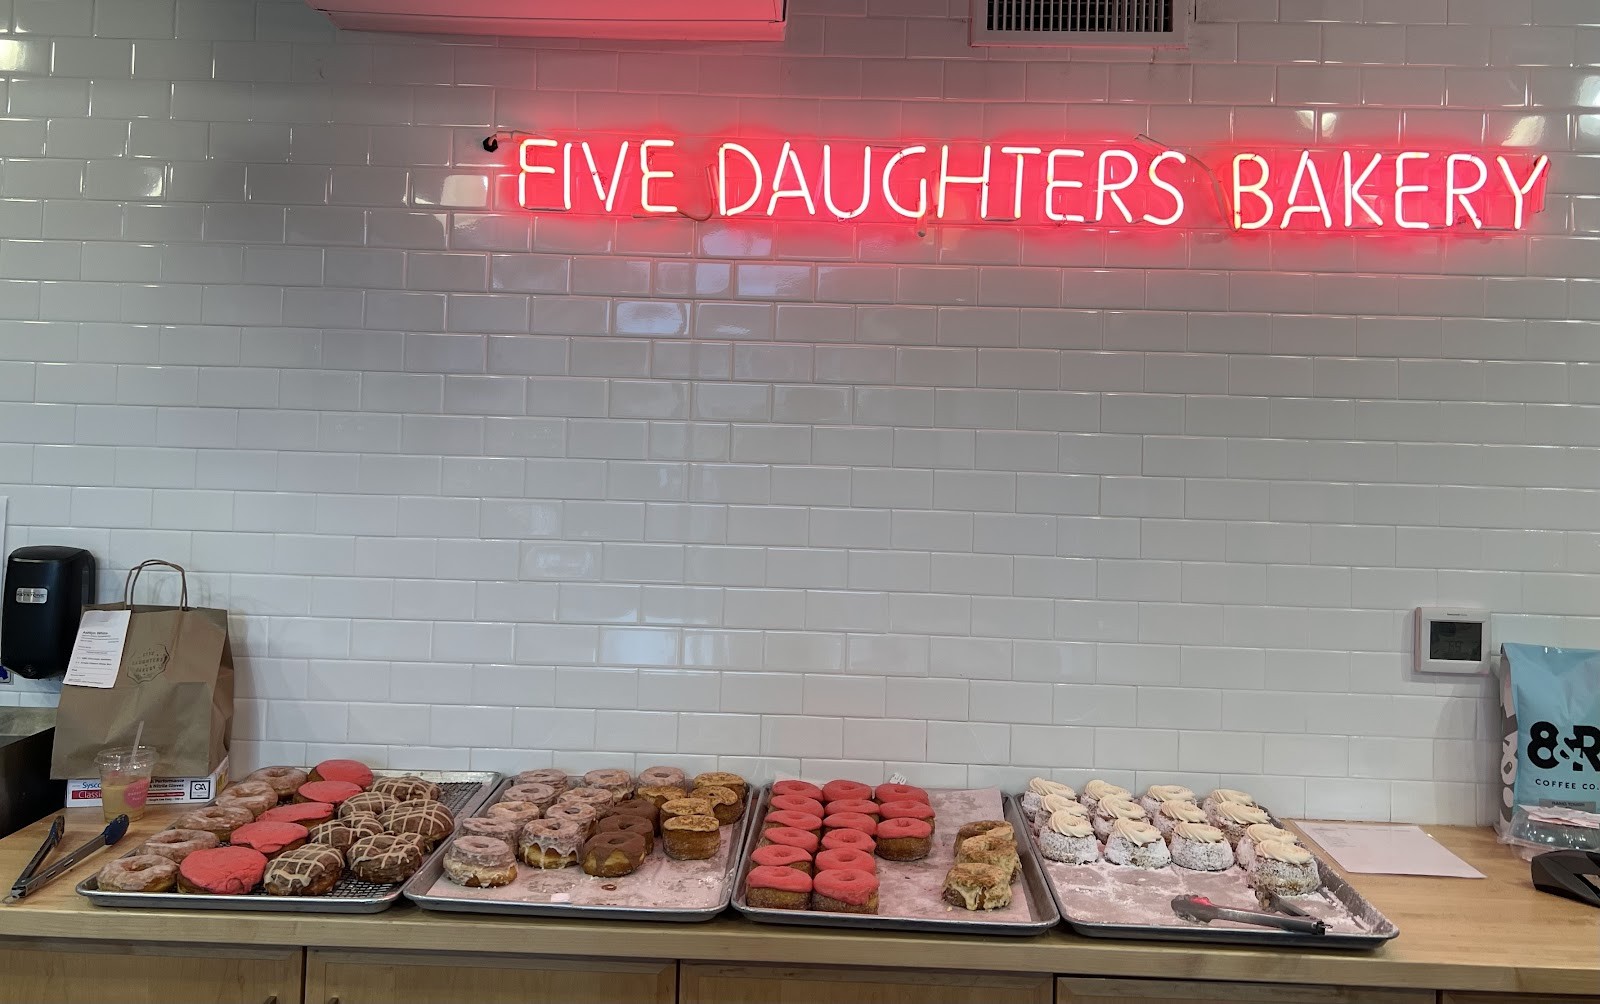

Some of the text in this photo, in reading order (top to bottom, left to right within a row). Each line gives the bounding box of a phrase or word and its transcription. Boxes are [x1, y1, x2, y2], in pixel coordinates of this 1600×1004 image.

[518, 139, 1549, 230] FIVE DAUGHTERS BAKERY
[1535, 778, 1577, 790] COFFEE
[78, 790, 102, 799] Classi
